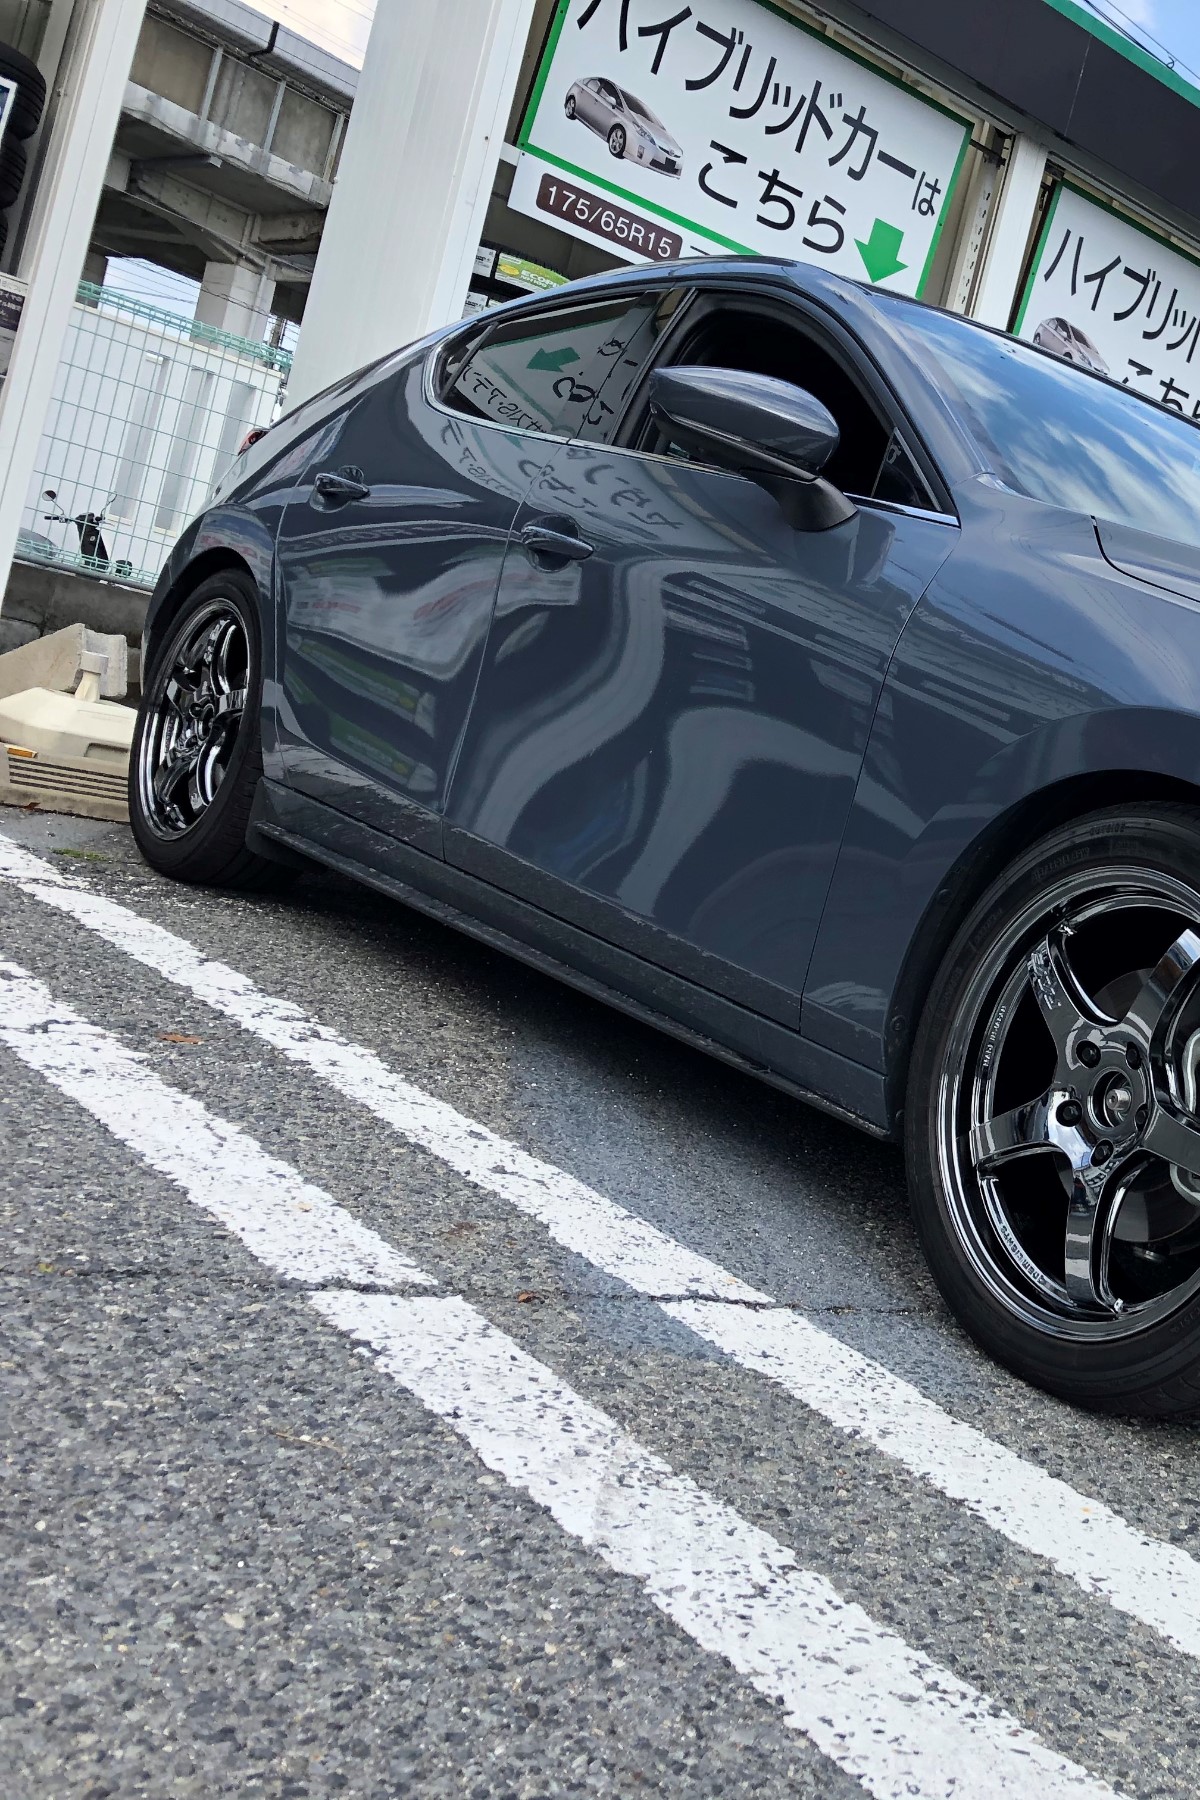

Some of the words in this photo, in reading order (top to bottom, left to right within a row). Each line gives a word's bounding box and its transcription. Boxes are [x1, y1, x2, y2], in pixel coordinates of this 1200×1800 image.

[545, 184, 674, 259] 175/65R15
[697, 139, 848, 254] こちら
